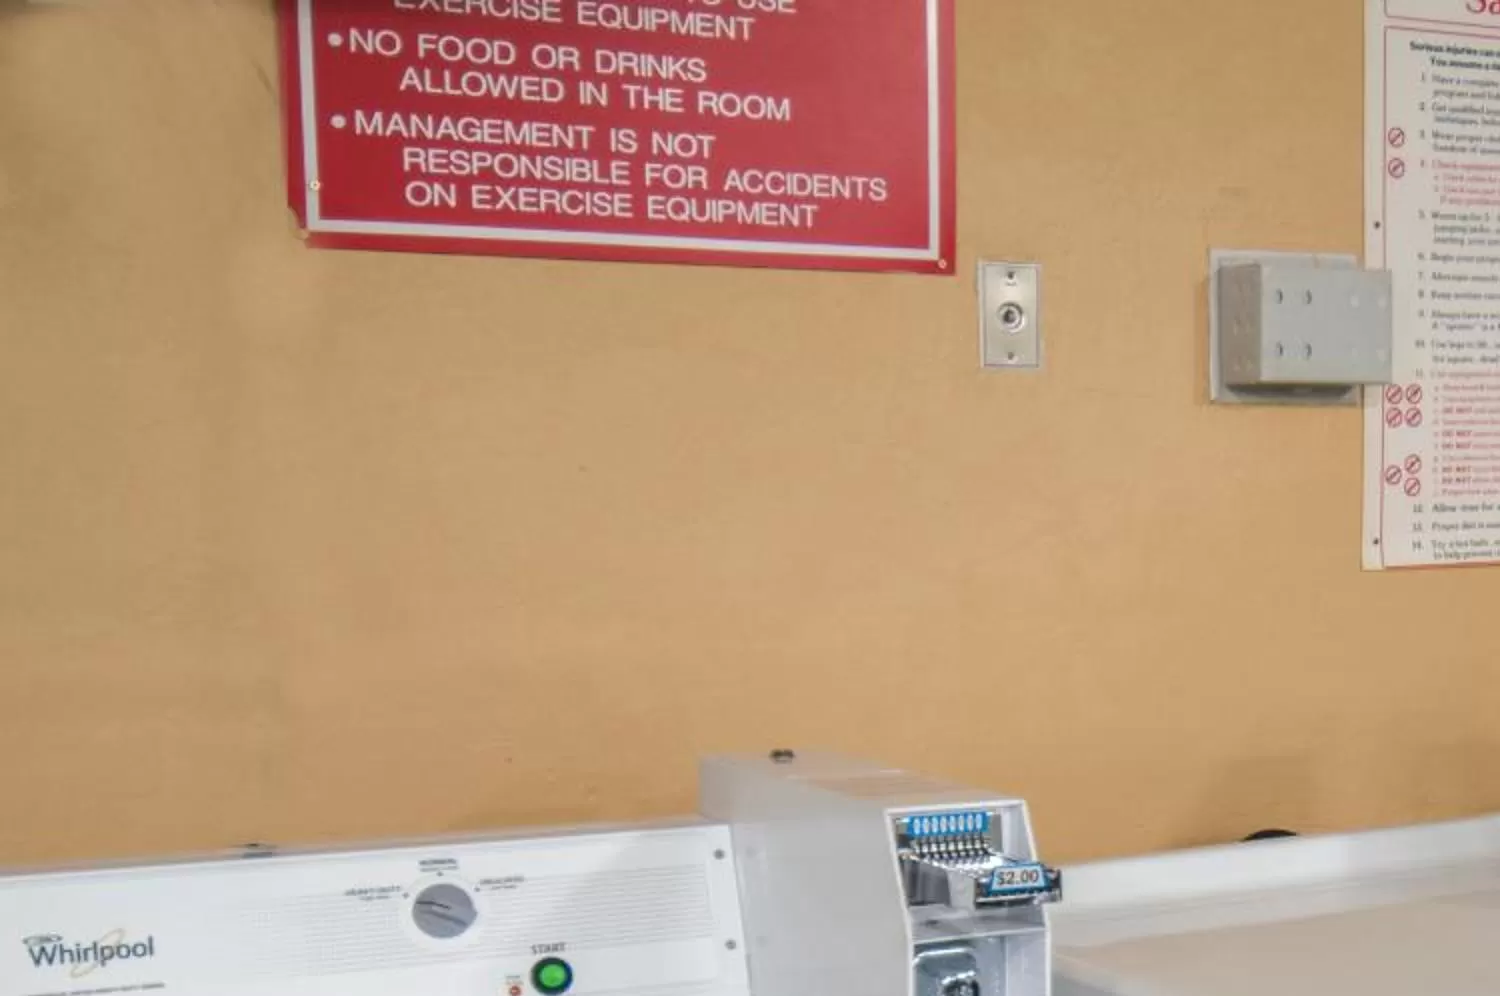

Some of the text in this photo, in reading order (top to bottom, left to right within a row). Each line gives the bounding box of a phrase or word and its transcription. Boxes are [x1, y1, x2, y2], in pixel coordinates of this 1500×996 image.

[577, 1, 756, 41] EQUIPMENT
[349, 28, 707, 83] NO FOOD OR DRINKS
[399, 67, 791, 121] ALLOWED IN THE ROOM
[354, 109, 716, 159] MANAGEMENT IS NOT
[402, 147, 888, 202] RESPONSIBLE FOR ACCIDENTS
[404, 180, 820, 228] ON EXERCISE EQUIPMENT
[24, 934, 155, 968] Whirlpool
